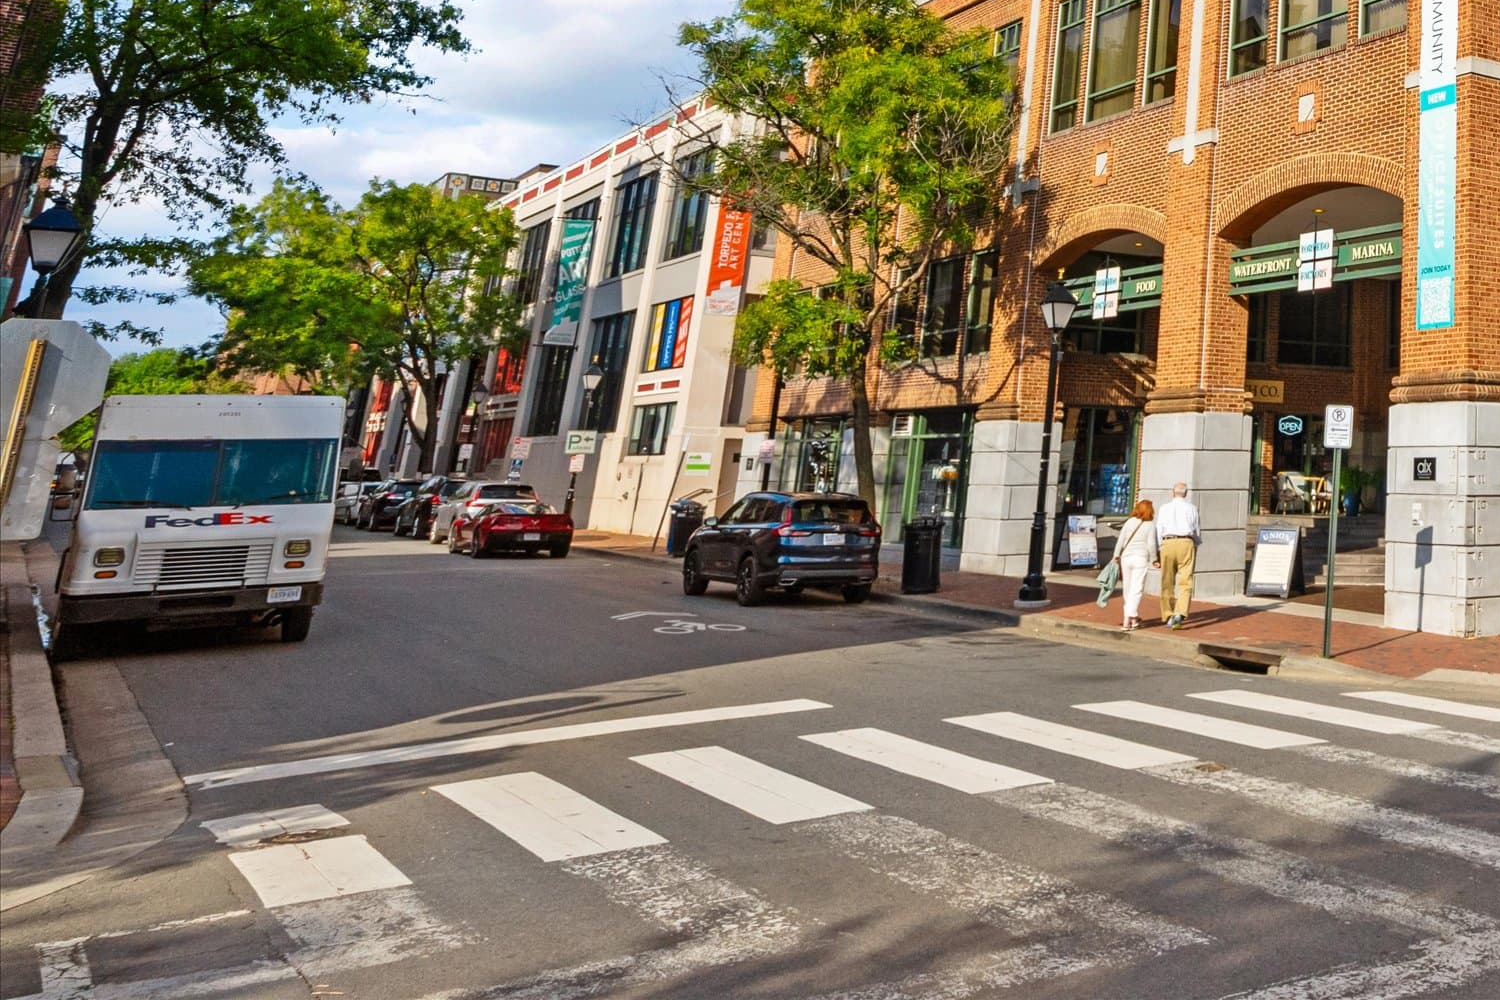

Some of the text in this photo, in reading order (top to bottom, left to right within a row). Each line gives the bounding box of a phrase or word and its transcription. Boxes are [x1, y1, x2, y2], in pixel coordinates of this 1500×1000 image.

[1427, 90, 1447, 105] NEW
[1433, 187, 1446, 250] SUITES
[717, 222, 734, 268] TORPEDO
[729, 248, 741, 270] ART
[1234, 242, 1394, 278] WATERFRONT MARINA
[1421, 264, 1451, 275] JOIN TODAY
[1136, 280, 1156, 293] FOOD
[1281, 422, 1300, 431] OPEN
[144, 512, 274, 529] FedEx
